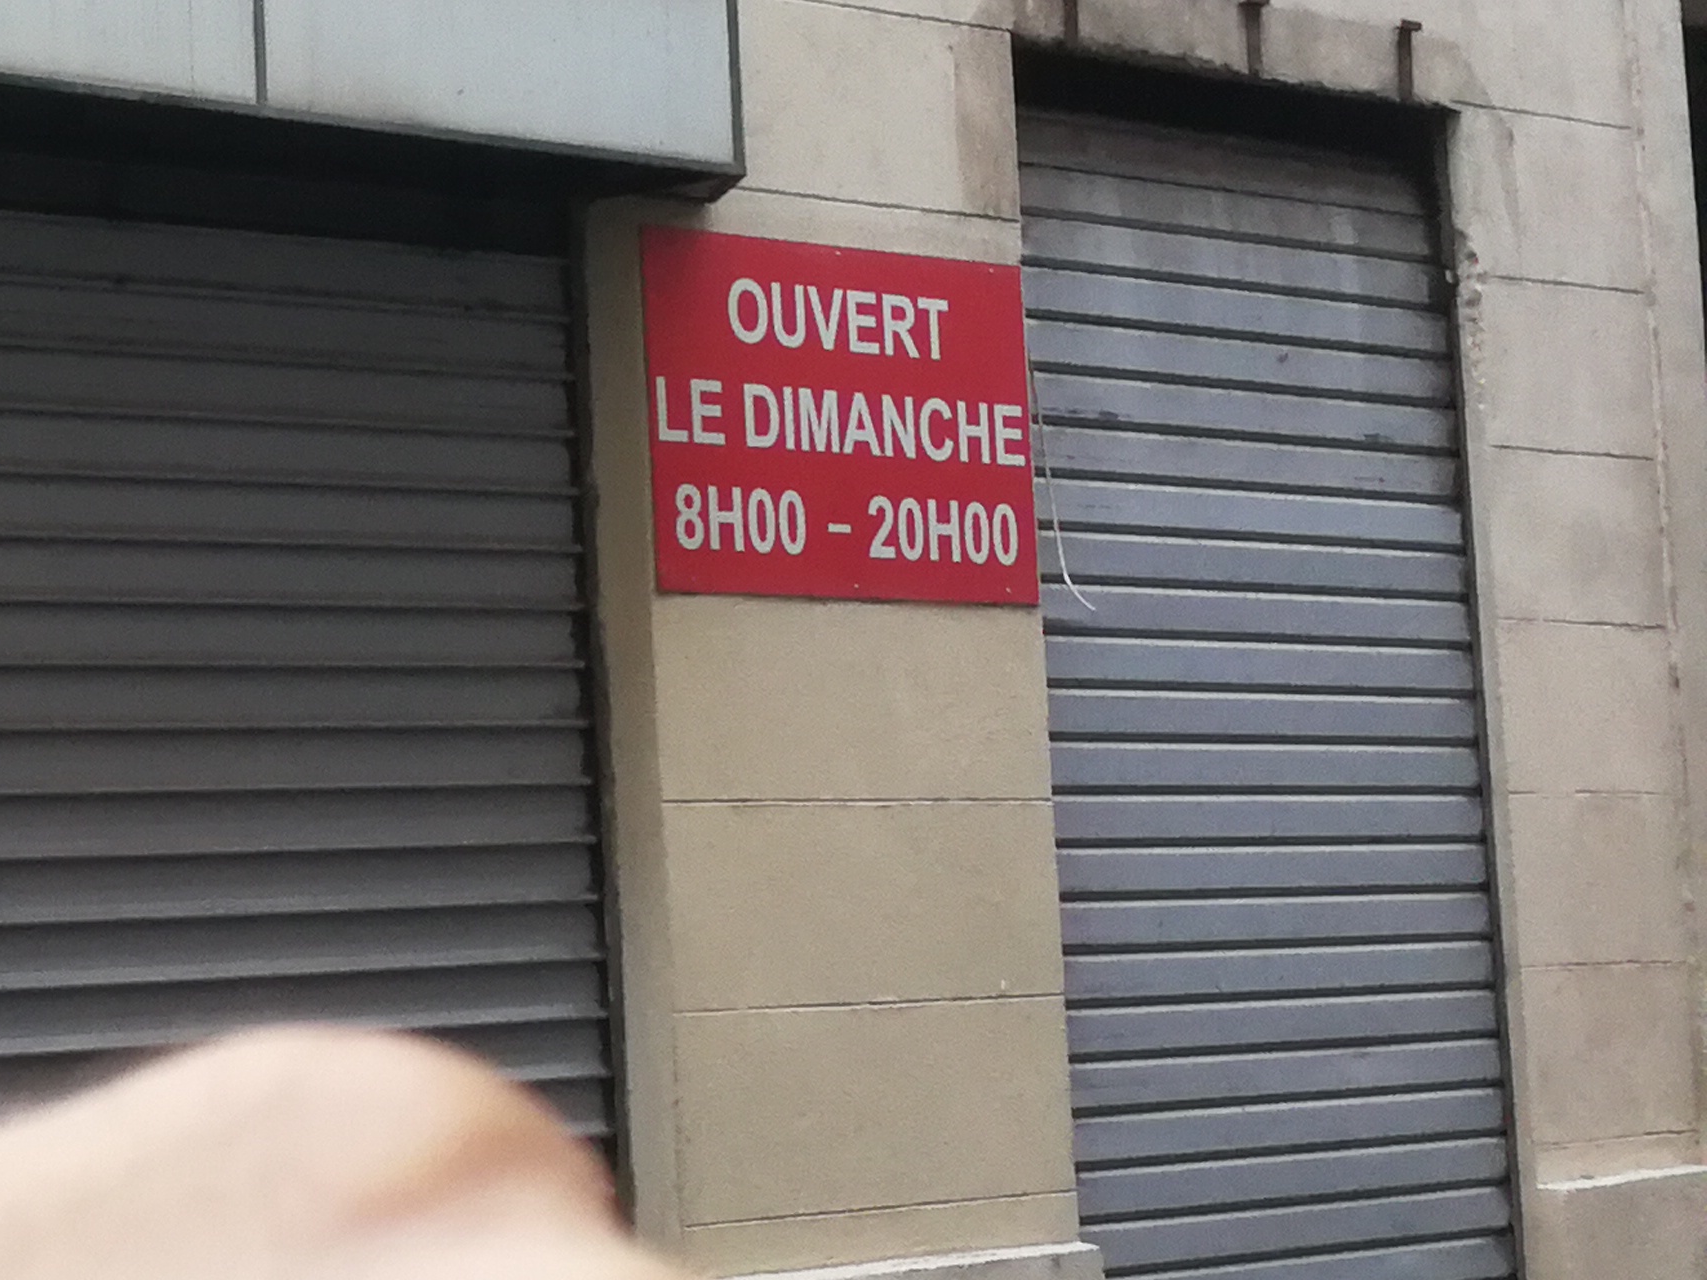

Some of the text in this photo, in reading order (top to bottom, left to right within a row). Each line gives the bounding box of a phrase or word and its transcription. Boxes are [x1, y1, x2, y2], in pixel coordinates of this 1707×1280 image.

[727, 277, 949, 360] OUVERT
[655, 376, 1026, 467] LE DIMANCHE
[675, 483, 1019, 566] 8H00 - 20H00
